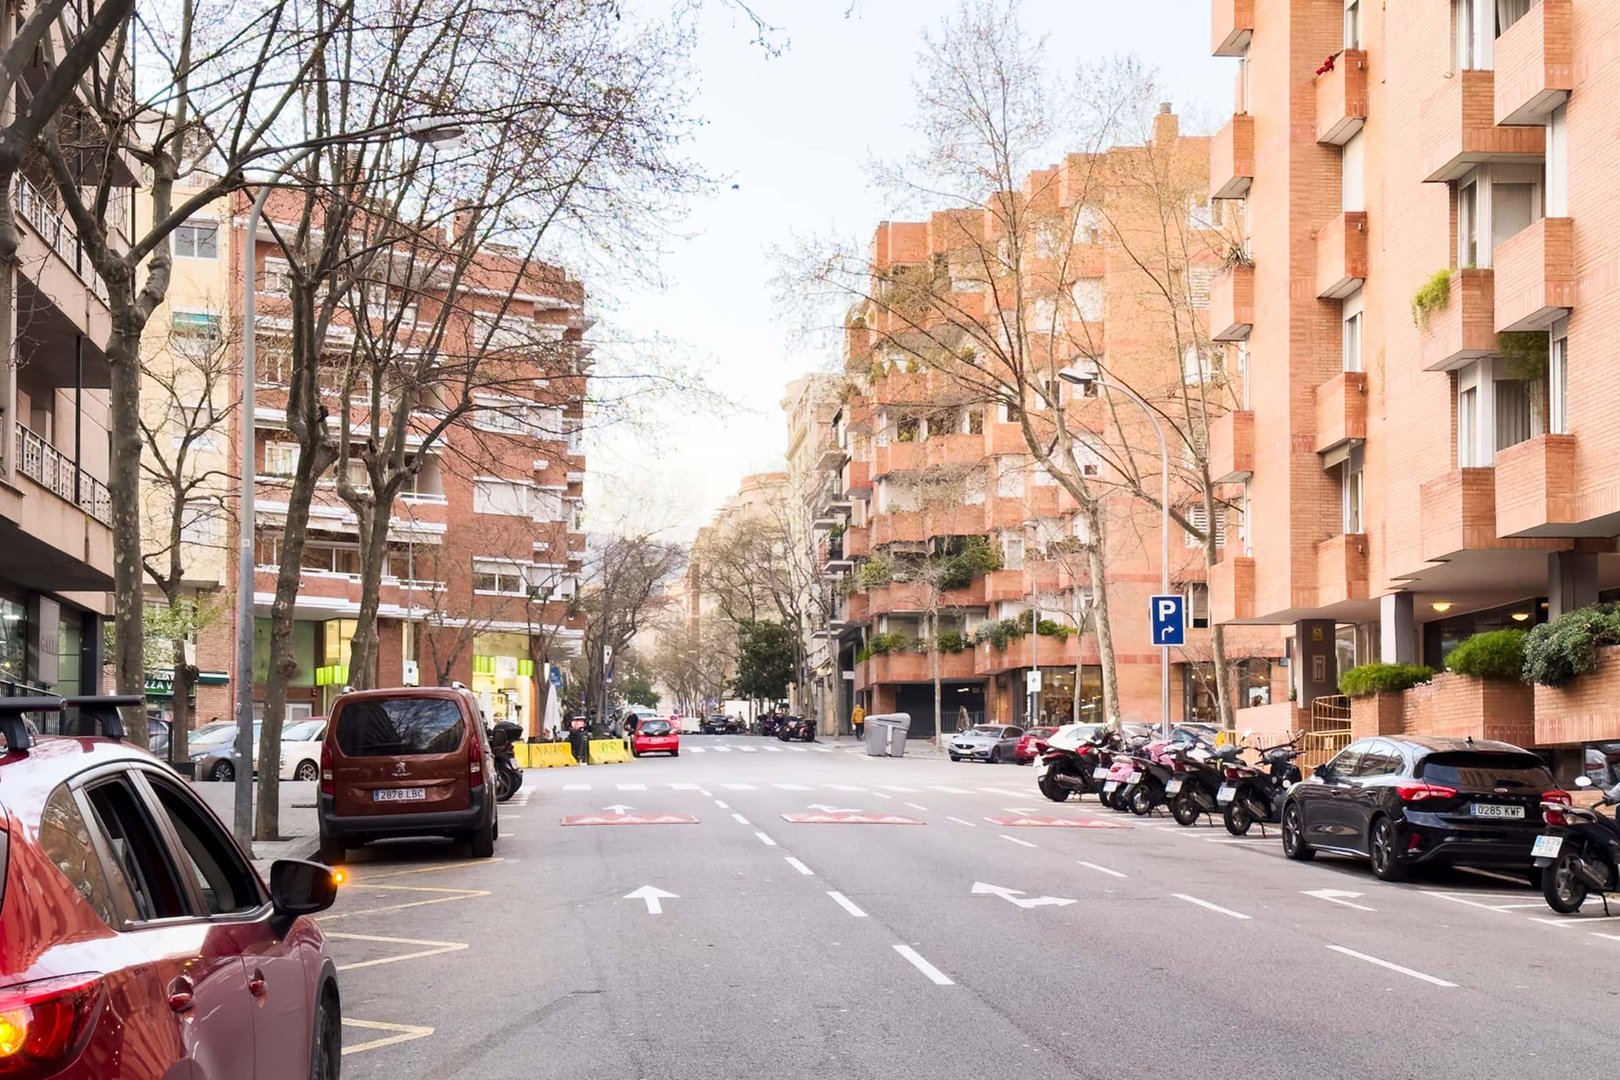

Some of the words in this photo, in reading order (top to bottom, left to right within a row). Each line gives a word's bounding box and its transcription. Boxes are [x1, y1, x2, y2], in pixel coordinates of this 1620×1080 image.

[1159, 600, 1176, 622] P
[380, 790, 404, 800] 2878
[405, 789, 425, 799] LBC
[1477, 804, 1502, 816] 0285
[1504, 806, 1522, 817] KWF
